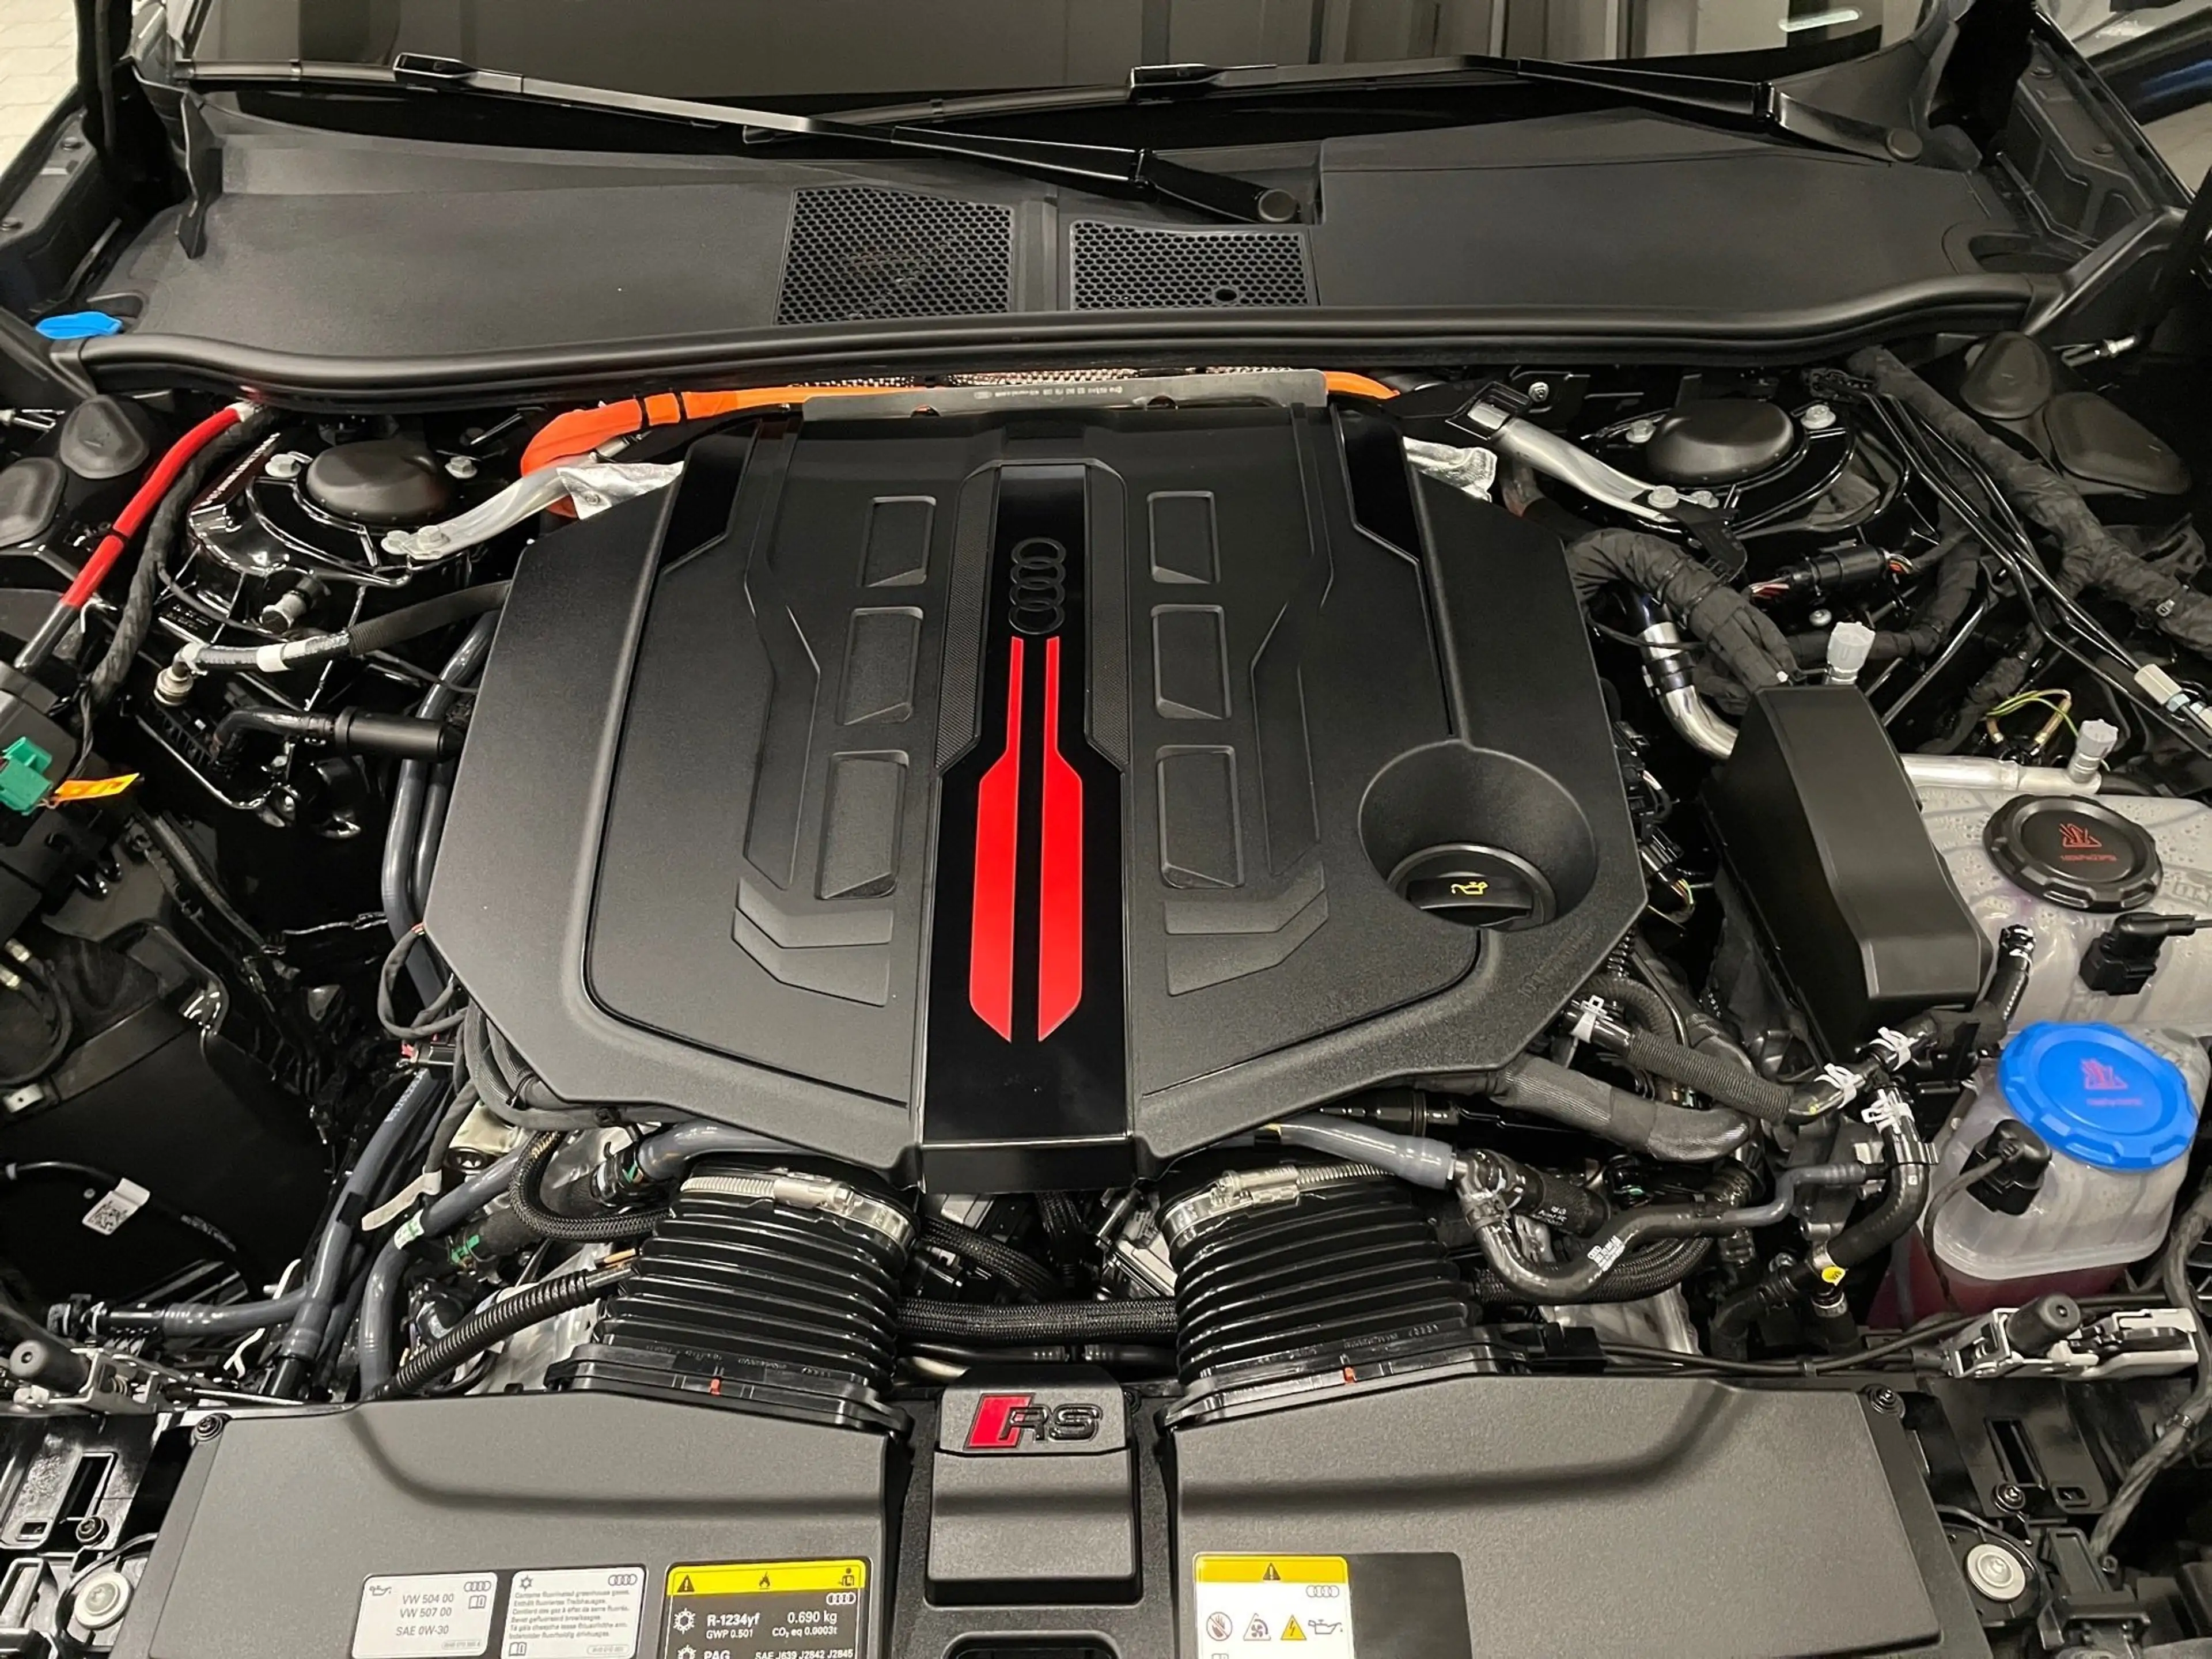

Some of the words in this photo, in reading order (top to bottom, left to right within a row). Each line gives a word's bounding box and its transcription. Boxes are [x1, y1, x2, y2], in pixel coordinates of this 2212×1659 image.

[998, 1403, 1103, 1442] RS
[403, 1594, 421, 1604] VW
[422, 1594, 440, 1604] 504
[442, 1593, 454, 1603] 00
[400, 1608, 418, 1618] VW
[419, 1608, 438, 1618] 507
[440, 1607, 452, 1616] 00
[707, 1612, 760, 1627] R-1234yf
[787, 1611, 820, 1624] 0.690
[823, 1610, 838, 1624] kg
[396, 1626, 416, 1636] SAE
[418, 1625, 449, 1635] 0W-30
[706, 1630, 729, 1639] GWP
[730, 1628, 753, 1639] 0.501
[791, 1628, 802, 1638] eq
[703, 1650, 730, 1659] PAG
[776, 1651, 798, 1659] J639
[798, 1650, 825, 1659] J2842
[827, 1649, 854, 1659] J2845
